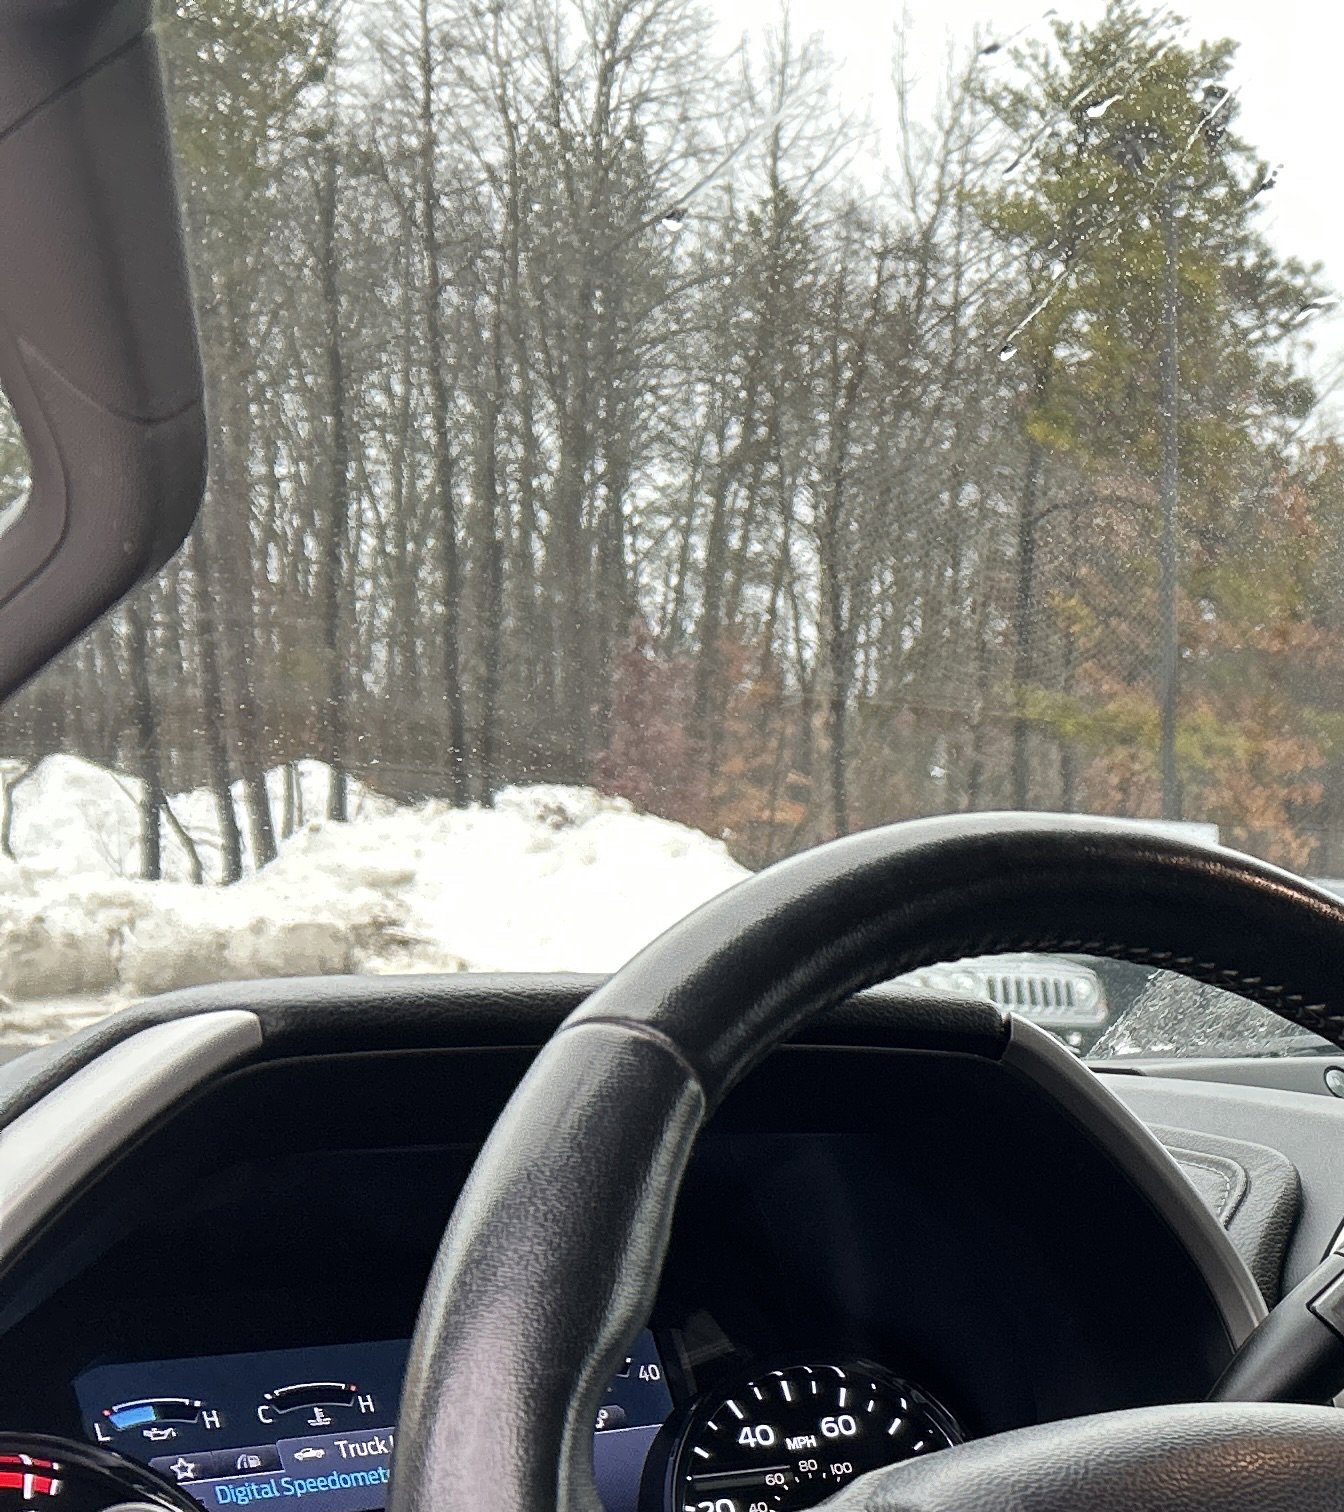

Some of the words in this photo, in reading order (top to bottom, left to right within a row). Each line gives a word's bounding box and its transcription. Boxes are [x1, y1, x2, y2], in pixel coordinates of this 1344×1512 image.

[820, 1414, 858, 1438] 60
[738, 1424, 776, 1448] 40
[785, 1435, 817, 1451] MPH
[333, 1436, 389, 1458] Truck
[798, 1459, 819, 1473] 80
[829, 1462, 854, 1476] 100
[215, 1477, 281, 1505] Digital
[282, 1466, 390, 1500] Speedomet
[765, 1472, 786, 1486] 60
